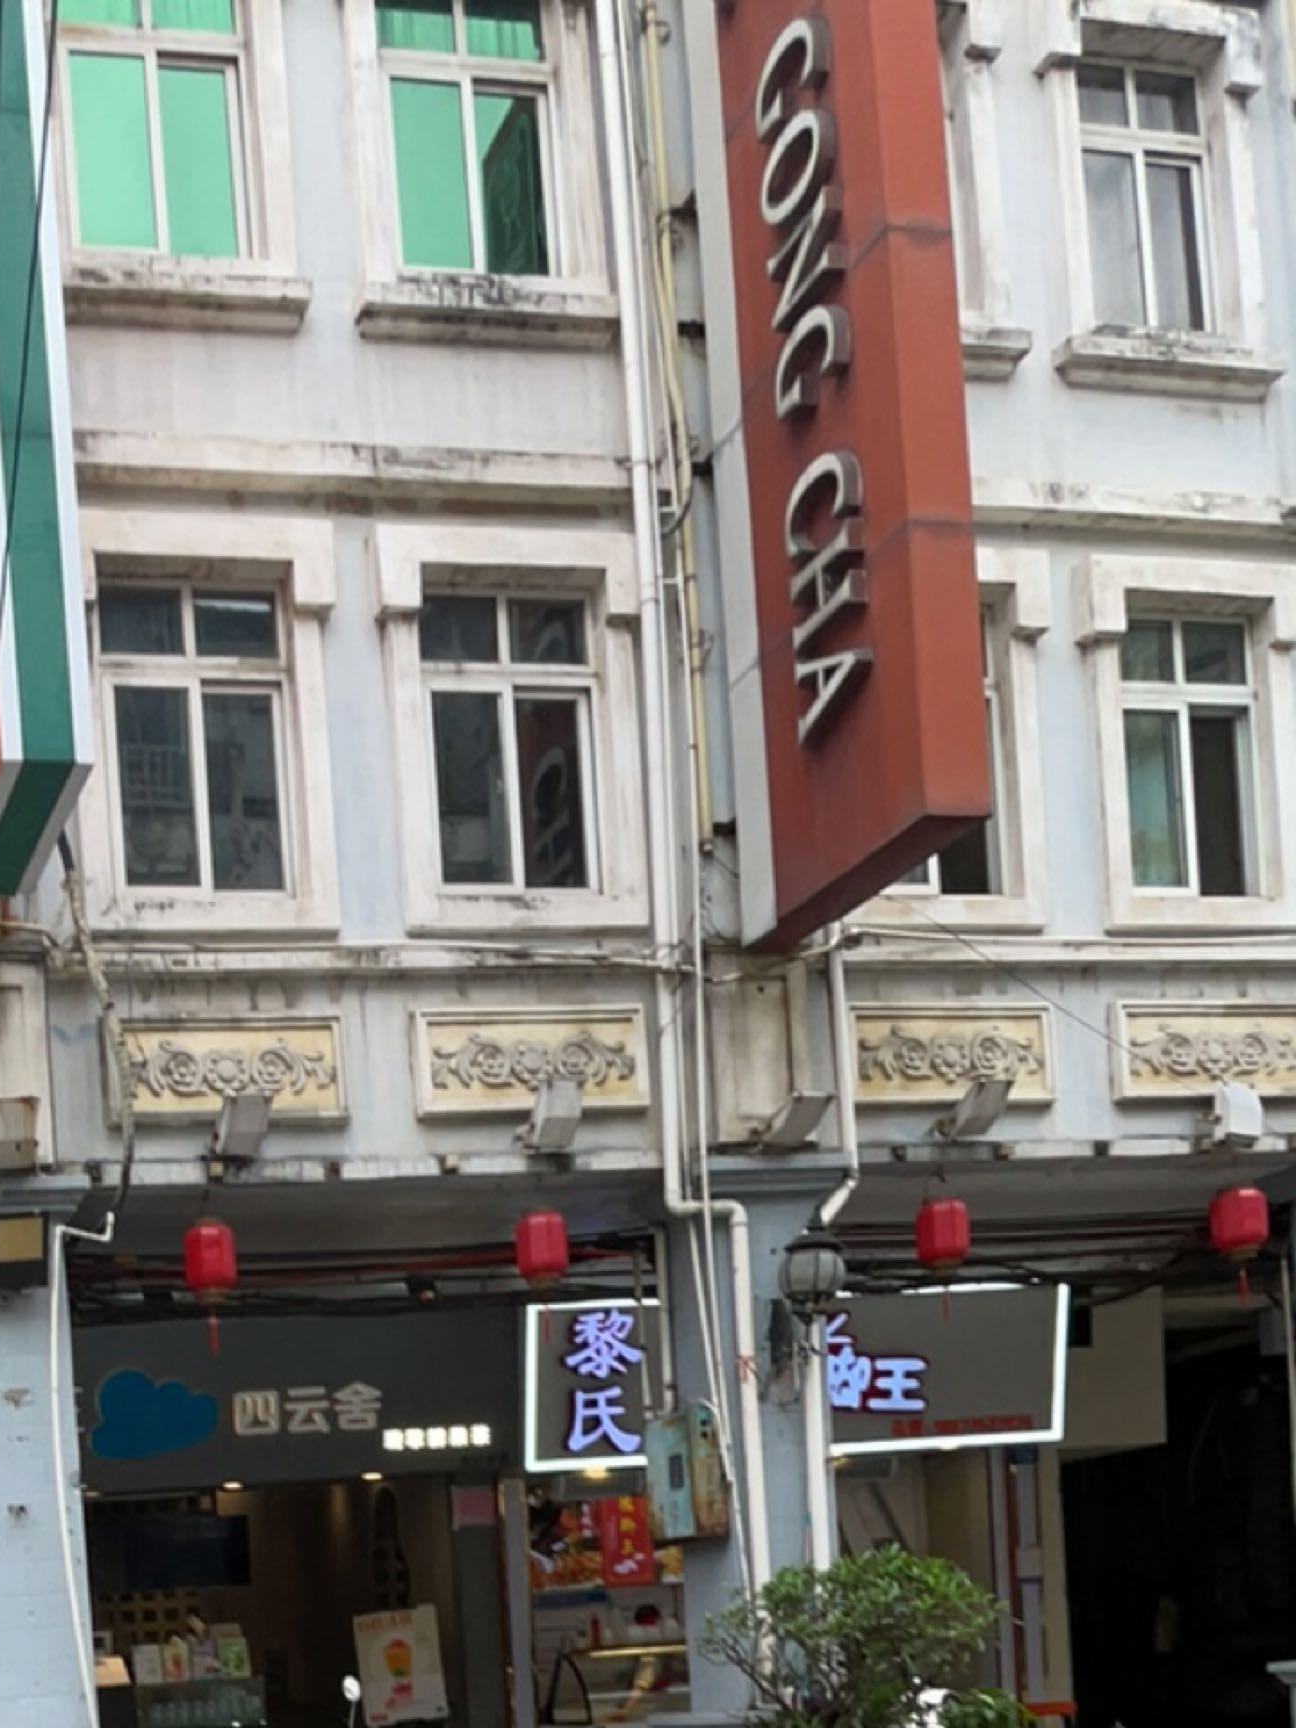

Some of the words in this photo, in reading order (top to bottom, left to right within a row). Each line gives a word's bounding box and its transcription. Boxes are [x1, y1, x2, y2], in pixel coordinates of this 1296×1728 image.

[755, 15, 850, 422] GONG
[786, 449, 872, 752] CHA
[233, 1382, 382, 1435] 四云舍
[565, 1308, 644, 1453] 黎氏
